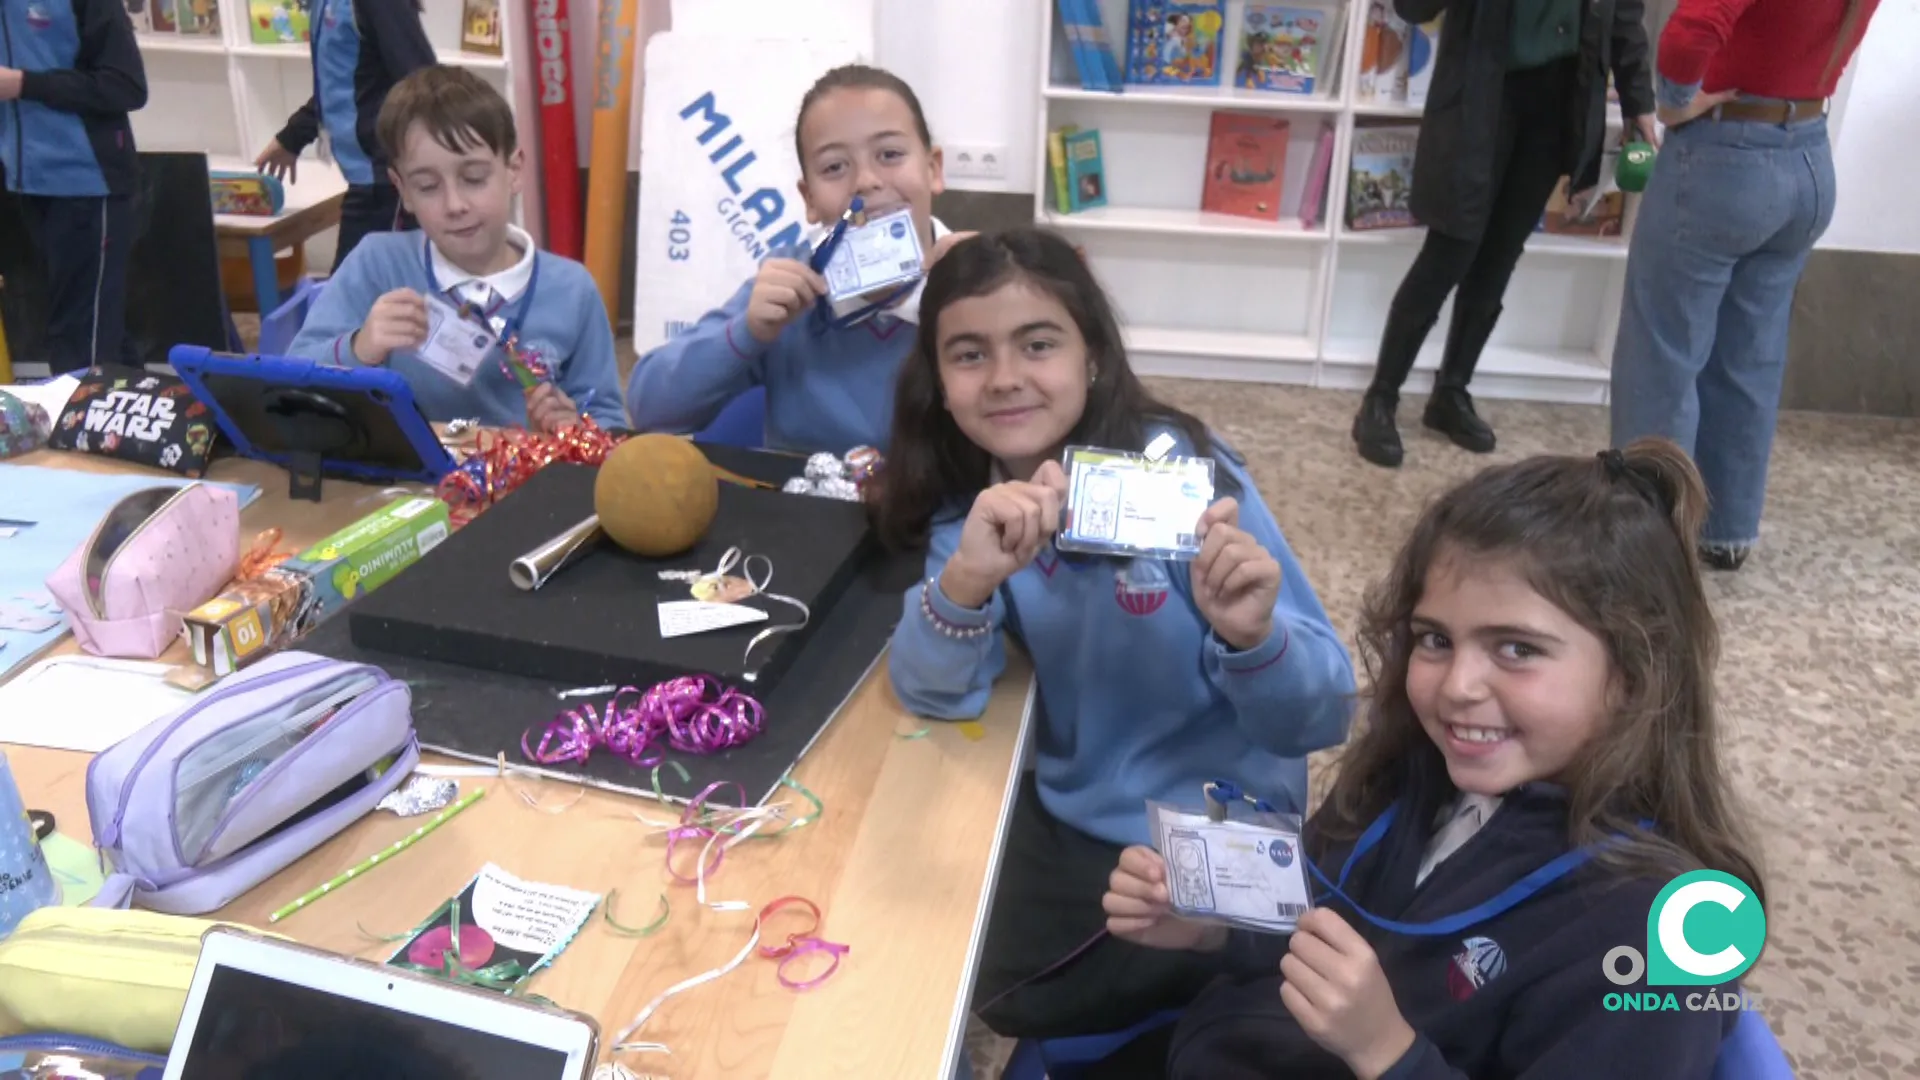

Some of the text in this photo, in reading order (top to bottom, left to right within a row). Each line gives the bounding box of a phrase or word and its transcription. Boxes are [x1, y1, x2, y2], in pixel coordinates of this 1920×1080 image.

[668, 209, 692, 262] 403
[91, 391, 177, 421] STAR
[84, 408, 173, 442] WARS
[360, 537, 413, 578] ALUMINIO
[238, 622, 257, 645] 10
